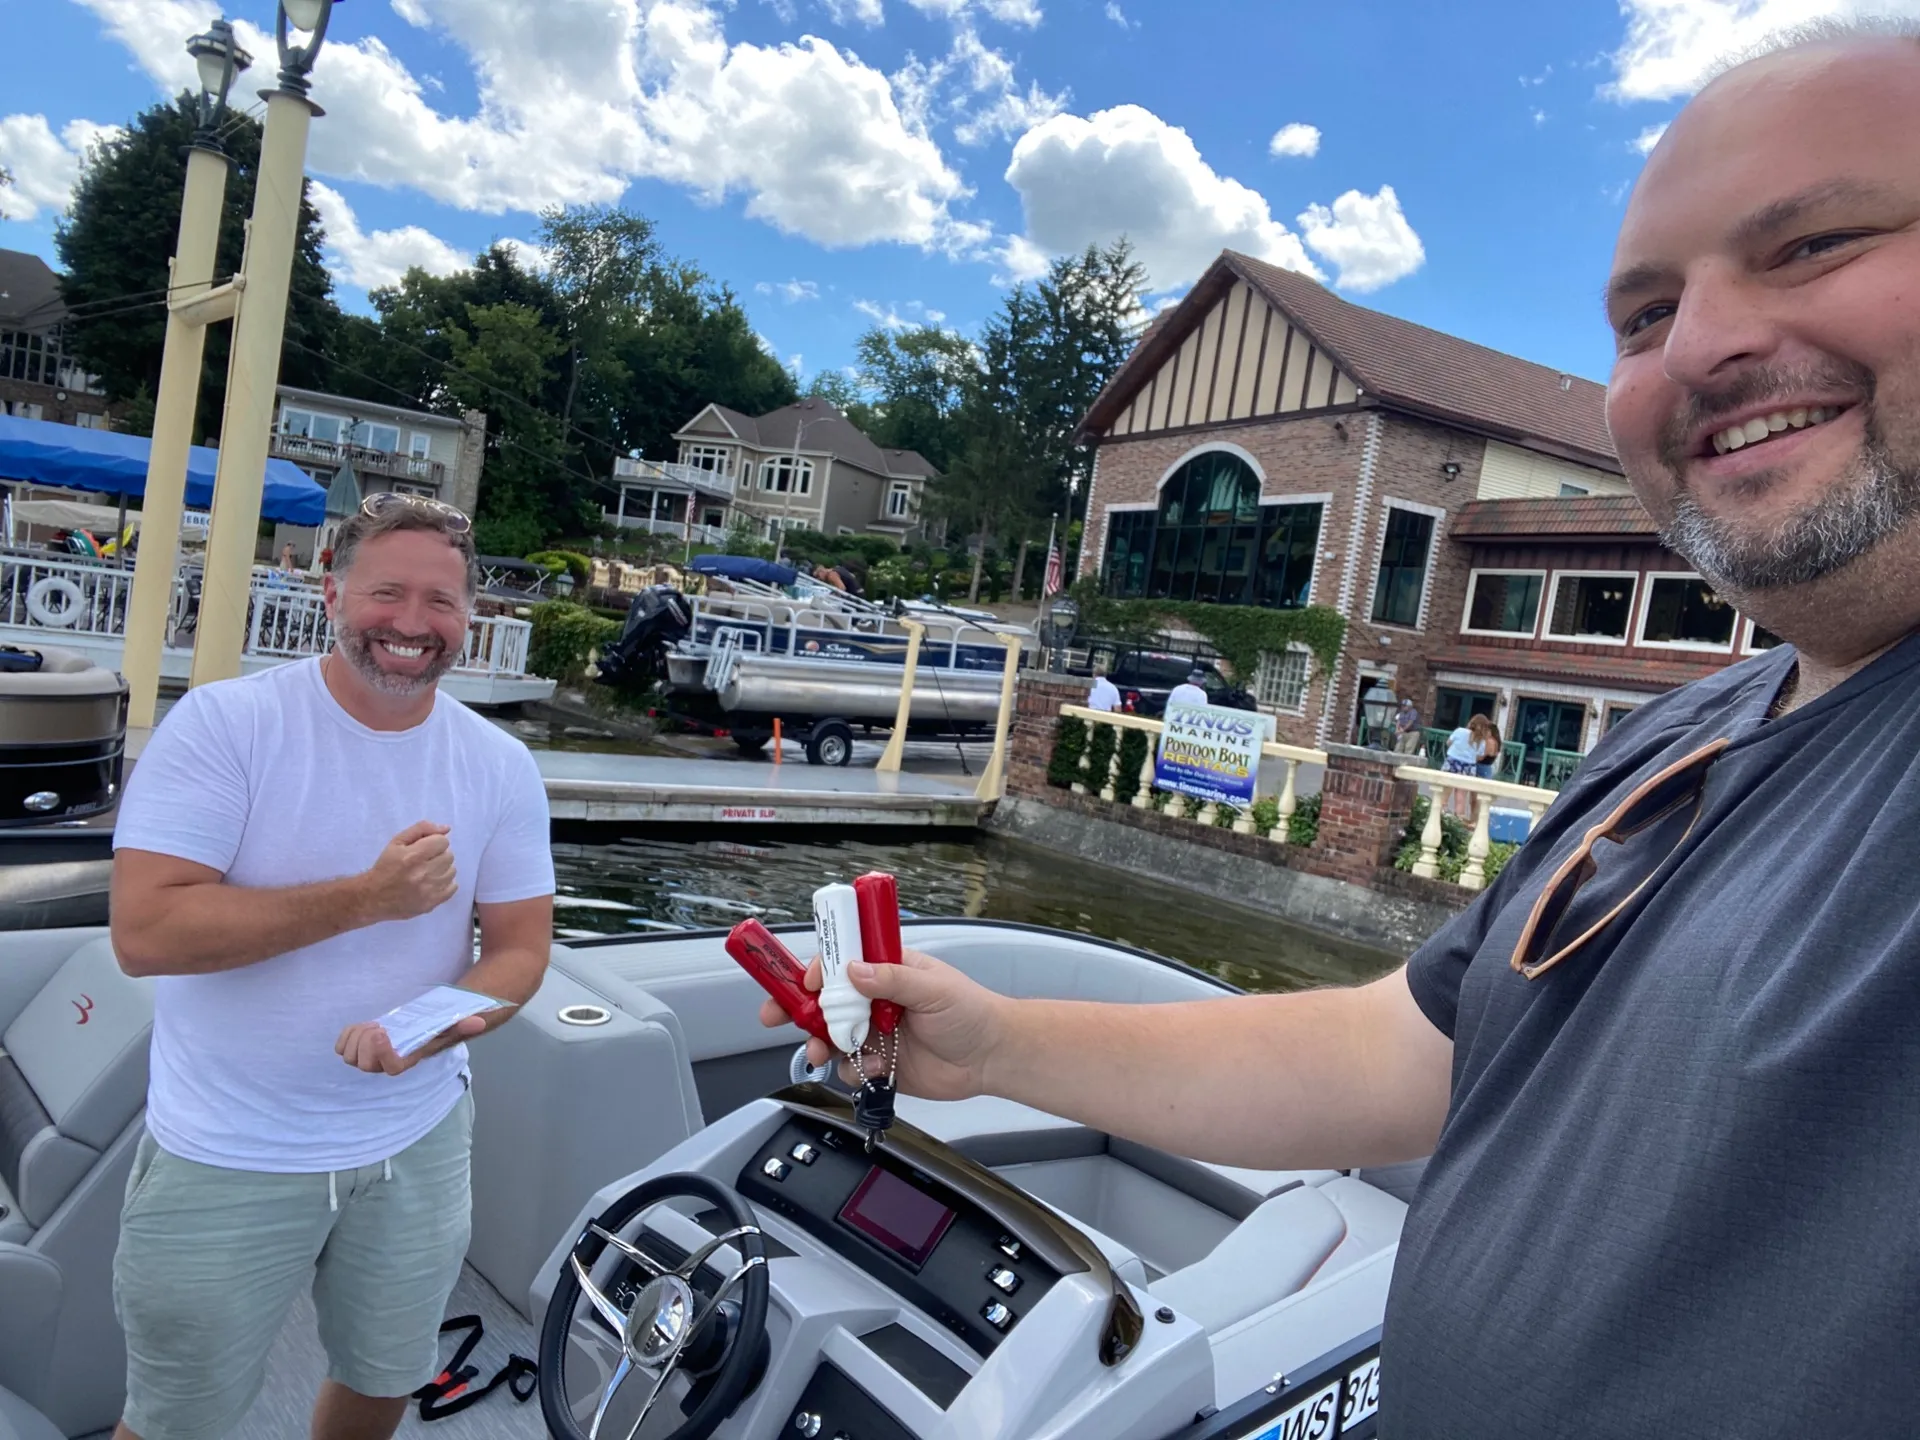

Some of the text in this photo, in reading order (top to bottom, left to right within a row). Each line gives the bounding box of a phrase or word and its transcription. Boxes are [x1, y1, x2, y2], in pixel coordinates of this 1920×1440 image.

[1172, 708, 1255, 735] TINUS
[1169, 724, 1251, 748] MARINE
[1163, 751, 1249, 778] RENTALS
[1157, 778, 1249, 804] www.tinusmarine.com
[722, 808, 777, 818] PRIVATE SLIP
[822, 918, 830, 940] HOUSE
[1282, 1392, 1335, 1440] WS
